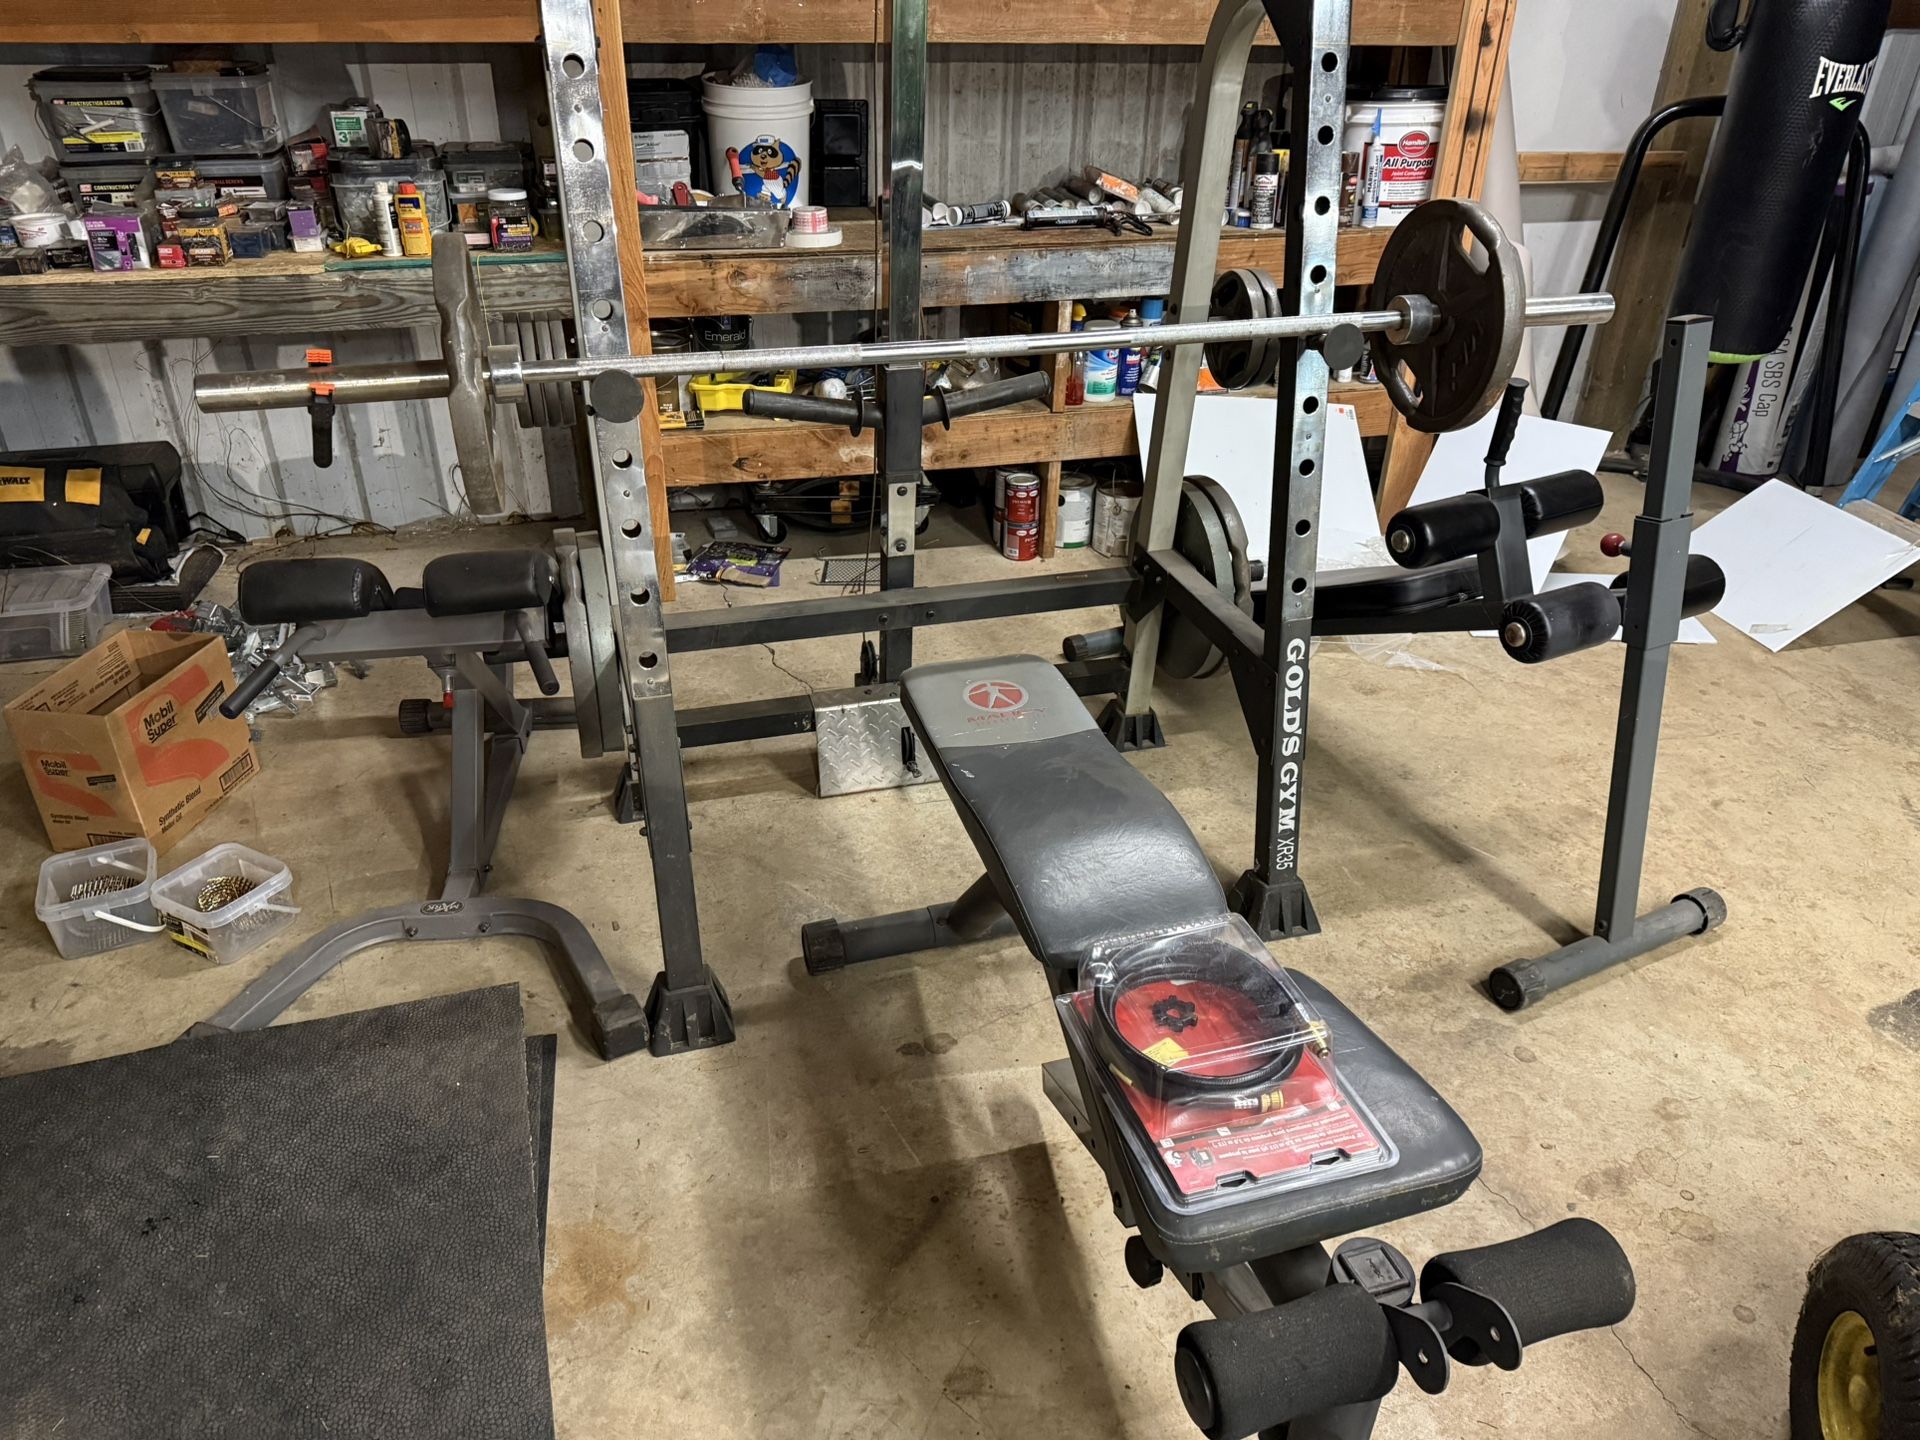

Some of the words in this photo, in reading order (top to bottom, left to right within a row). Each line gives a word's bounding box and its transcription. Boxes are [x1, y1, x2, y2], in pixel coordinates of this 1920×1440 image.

[1809, 56, 1878, 99] EVERLAST
[1383, 157, 1399, 168] All
[1366, 166, 1374, 193] MARINE
[704, 329, 746, 343] Emerald
[1761, 360, 1785, 389] SBS
[1752, 393, 1778, 418] Cap
[0, 477, 31, 486] WALT
[1281, 638, 1306, 757] GOLD'S
[143, 700, 175, 730] Mobil
[147, 714, 178, 741] Super
[40, 759, 67, 769] Mobil
[159, 800, 185, 826] Synthetic
[185, 785, 202, 804] Blend
[1278, 761, 1299, 834] GYM
[1276, 837, 1296, 871] XR35
